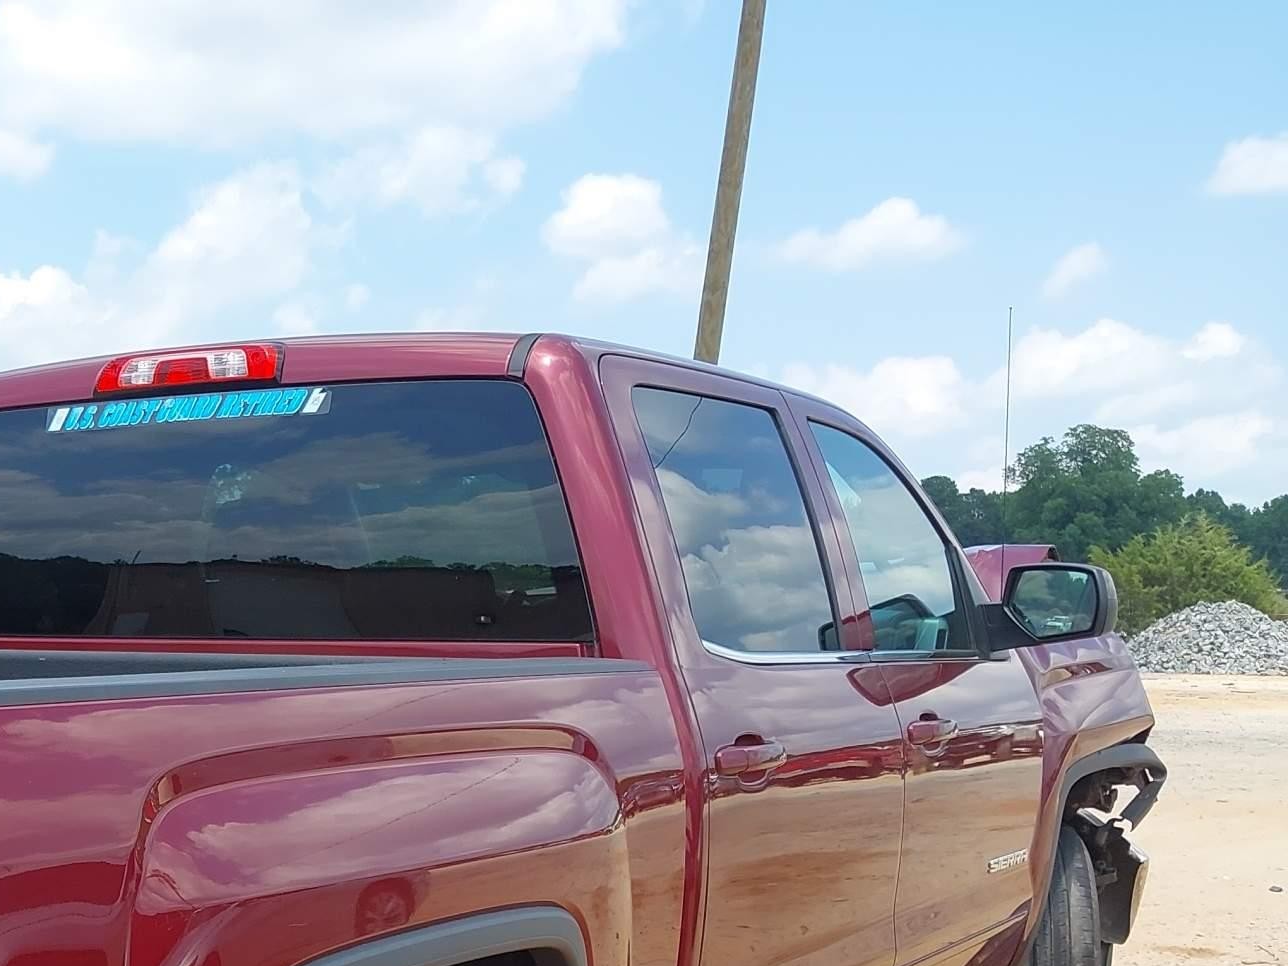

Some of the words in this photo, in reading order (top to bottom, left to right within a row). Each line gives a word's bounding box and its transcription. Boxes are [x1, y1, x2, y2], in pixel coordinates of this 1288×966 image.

[97, 399, 160, 428] COAST
[156, 395, 223, 424] GUARD
[216, 389, 309, 419] RETIRED
